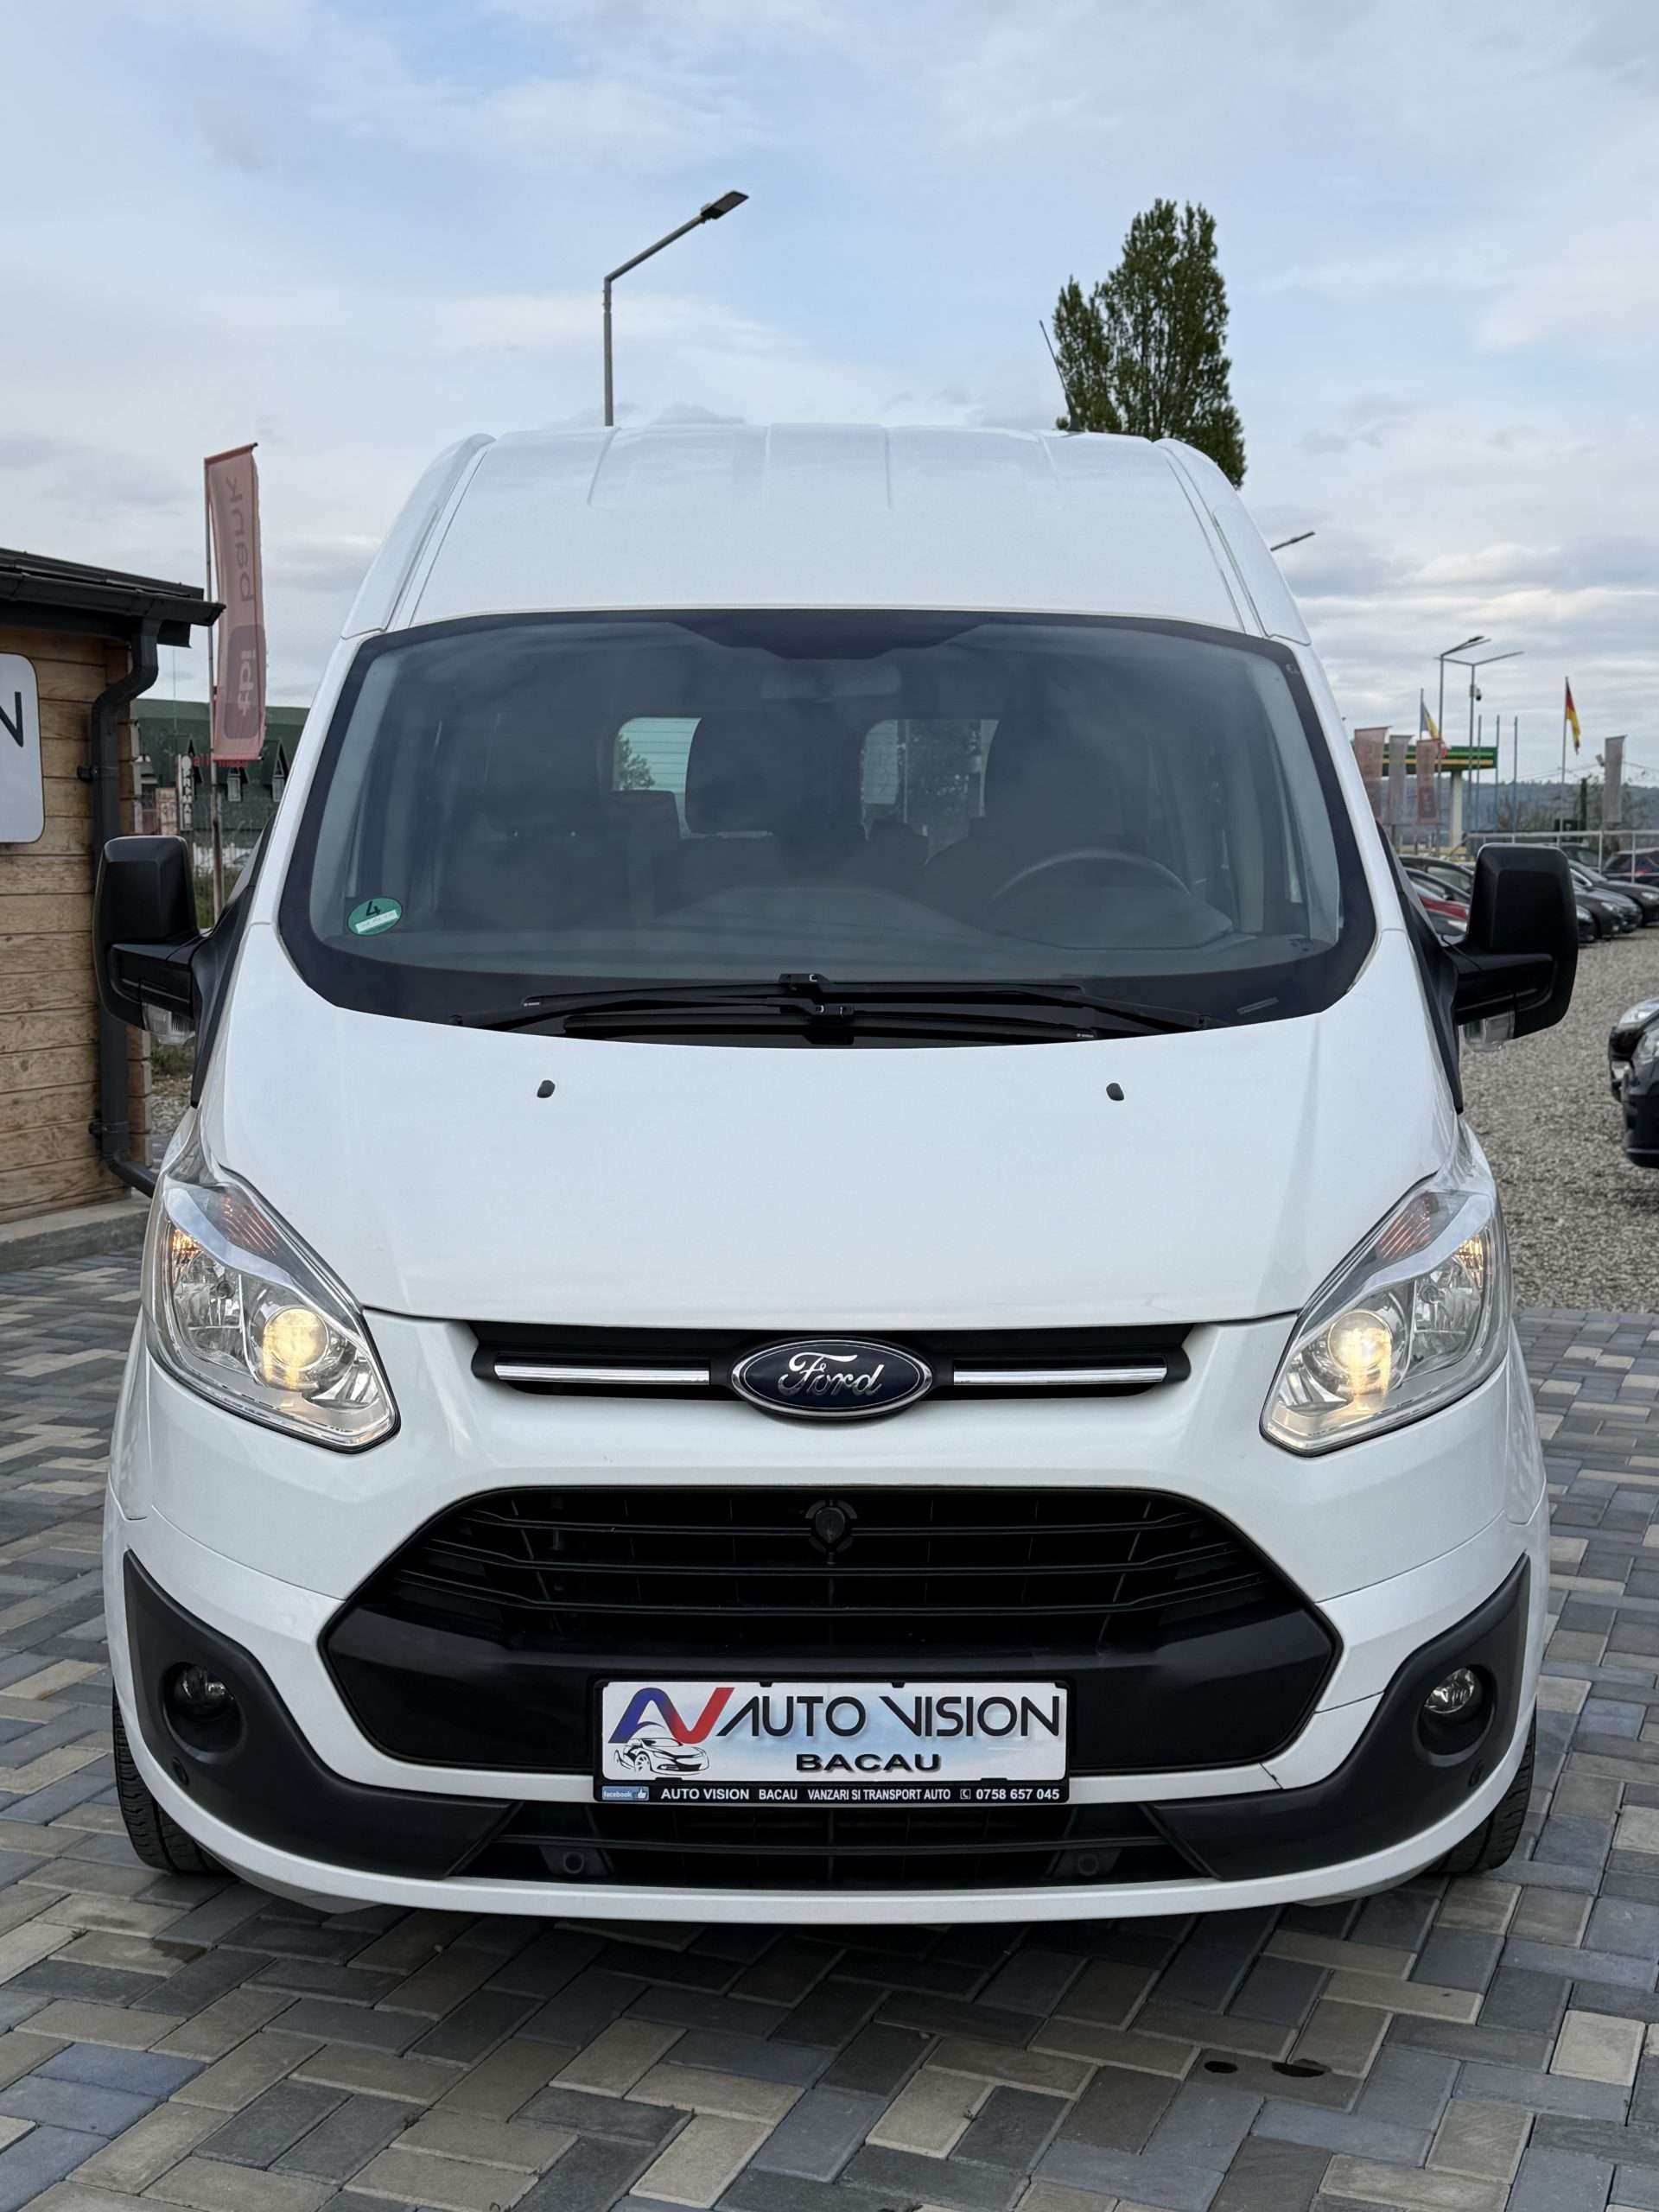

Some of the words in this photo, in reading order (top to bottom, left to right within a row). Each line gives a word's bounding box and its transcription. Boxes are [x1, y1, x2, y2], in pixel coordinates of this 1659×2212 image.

[366, 900, 381, 917] 4
[778, 1351, 886, 1396] Ford
[715, 1695, 866, 1737] AUTO
[879, 1695, 1060, 1737] VISION
[796, 1753, 941, 1772] BACAU
[661, 1789, 700, 1800] AUTO
[703, 1789, 749, 1800] VISION
[759, 1789, 798, 1801] BACAU
[807, 1789, 849, 1801] VANZARI
[851, 1789, 861, 1801] SI
[863, 1789, 922, 1801] TRANSPORT
[924, 1789, 951, 1801] AUTO
[976, 1789, 1006, 1800] 0758
[1010, 1789, 1033, 1800] 657
[1036, 1789, 1060, 1800] 045
